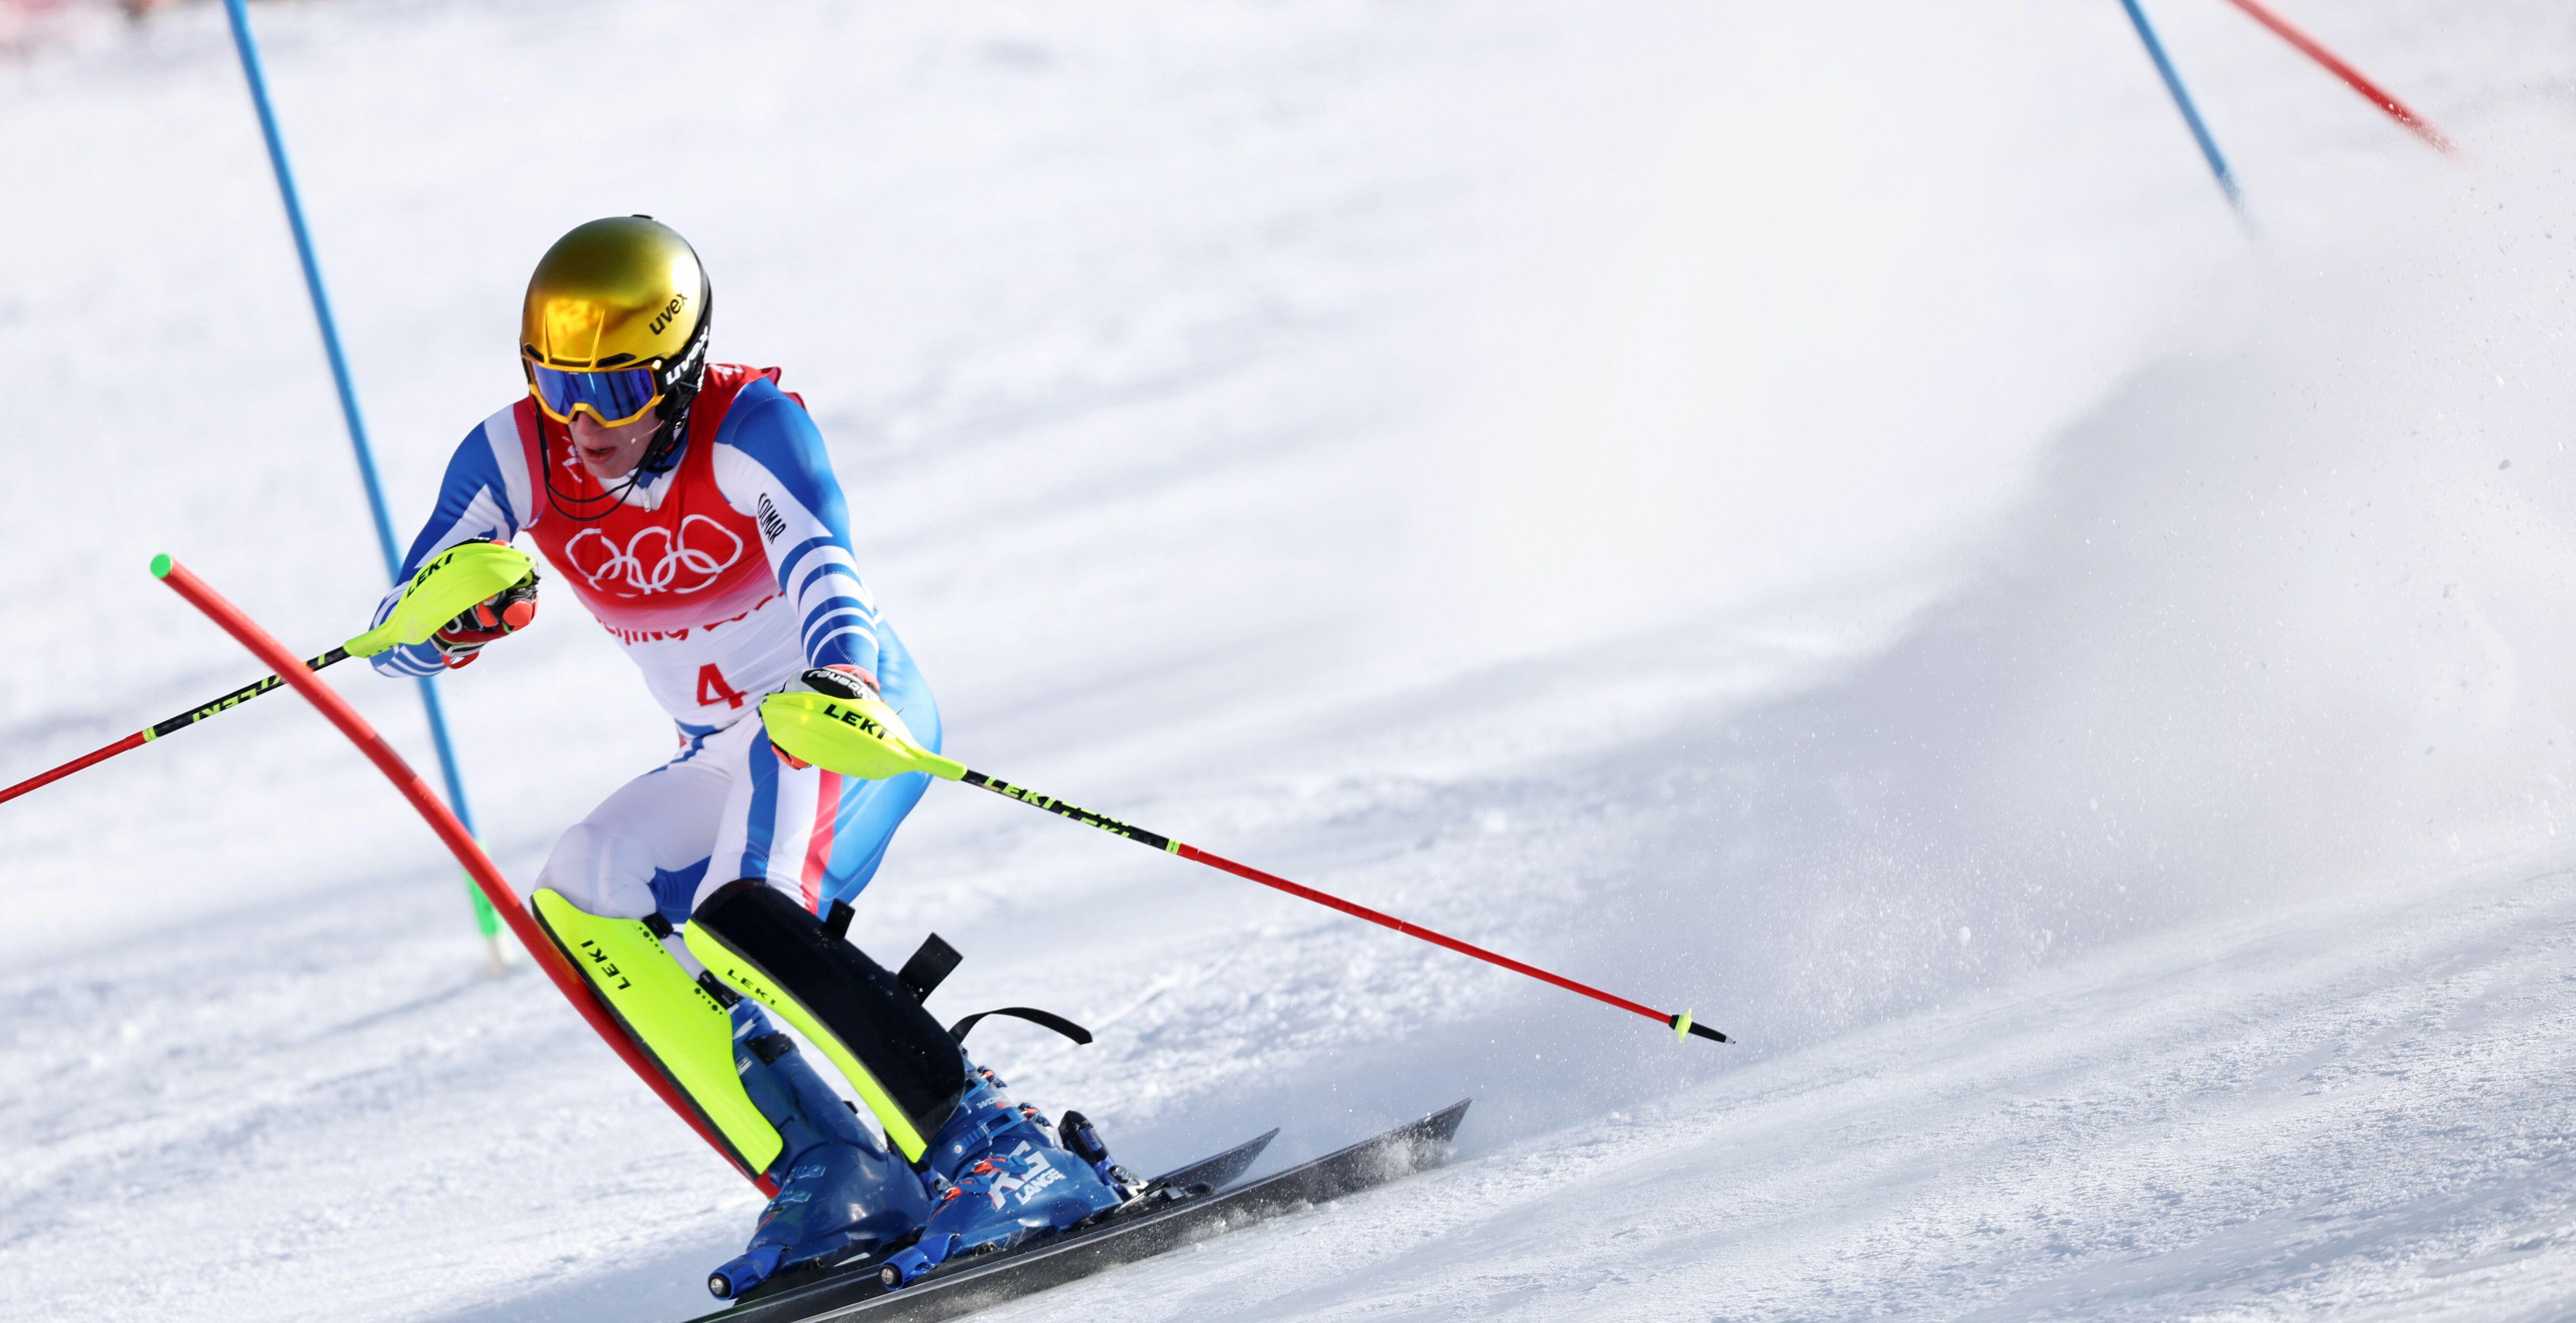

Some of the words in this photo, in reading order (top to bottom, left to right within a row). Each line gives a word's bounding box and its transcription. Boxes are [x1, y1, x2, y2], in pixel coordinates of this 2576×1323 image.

[649, 291, 688, 335] uvex
[758, 493, 786, 545] COLMAR
[406, 552, 454, 598] LEKI
[697, 663, 747, 709] 4
[823, 704, 888, 740] LEKI
[982, 776, 1057, 809] LEKI
[581, 940, 632, 990] LEKI
[727, 969, 776, 1005] LEKI
[1014, 1167, 1062, 1205] LANGE
